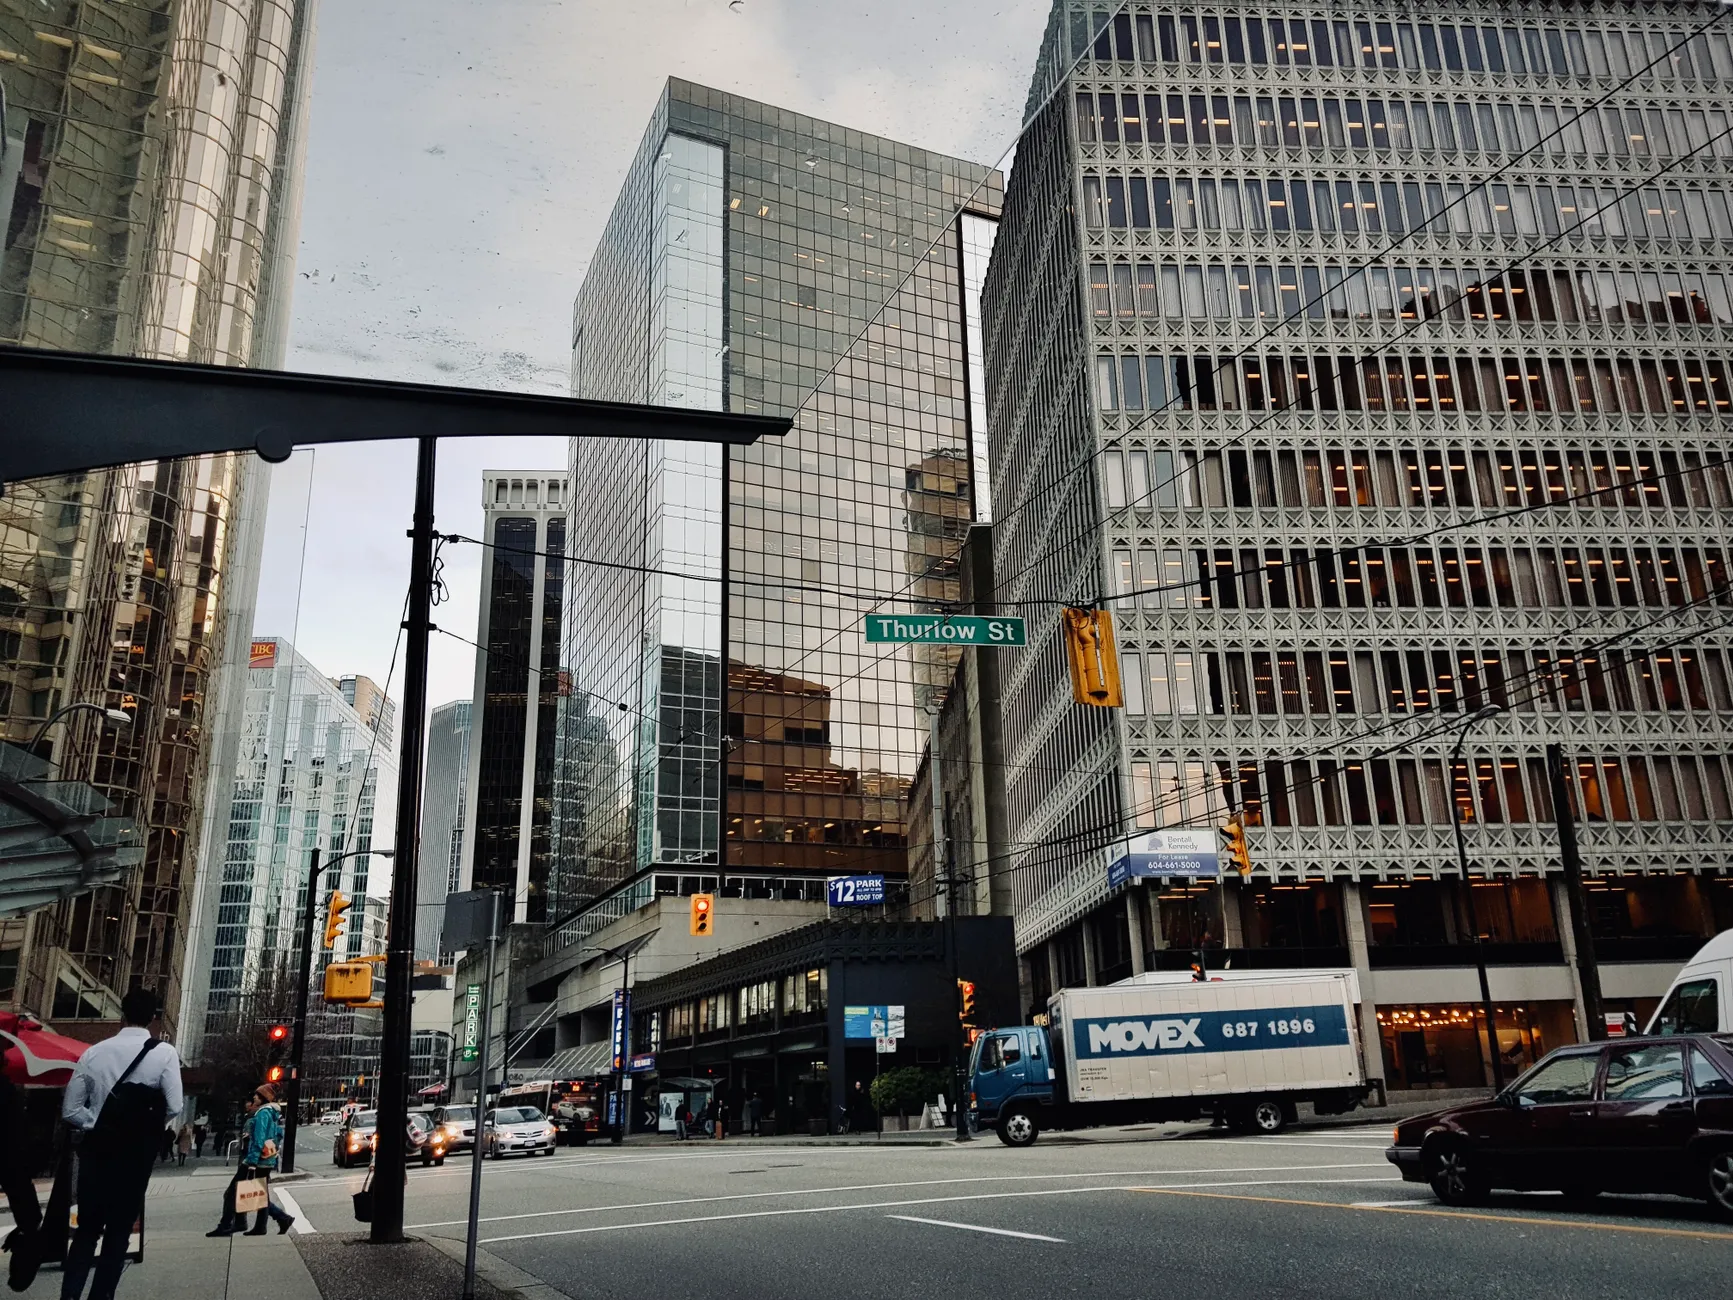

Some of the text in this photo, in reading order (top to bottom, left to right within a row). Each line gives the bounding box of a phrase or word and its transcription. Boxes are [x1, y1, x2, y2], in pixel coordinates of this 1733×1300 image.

[877, 619, 1015, 641] Thurlow St
[1168, 842, 1199, 851] Kennedy
[1148, 861, 1201, 869] 604-661-5000
[830, 880, 882, 902] $12 PARK
[467, 996, 477, 1046] PARK
[1088, 1018, 1315, 1053] MOVEX 687 1896
